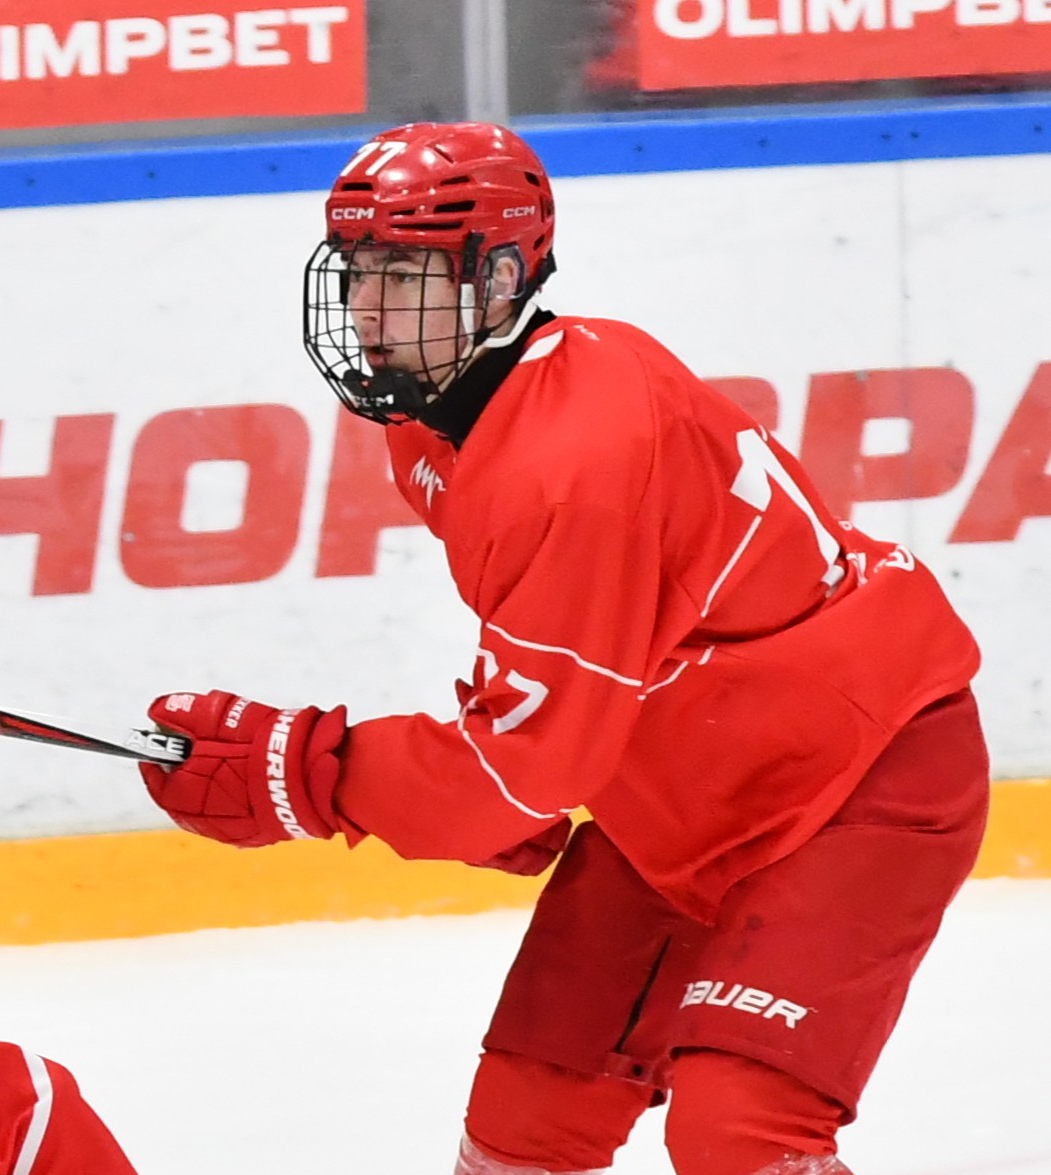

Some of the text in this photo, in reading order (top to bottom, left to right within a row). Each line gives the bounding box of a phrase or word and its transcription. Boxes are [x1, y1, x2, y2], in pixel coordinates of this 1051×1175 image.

[339, 141, 407, 176] 77
[331, 207, 376, 220] CCM
[502, 206, 536, 219] CCM
